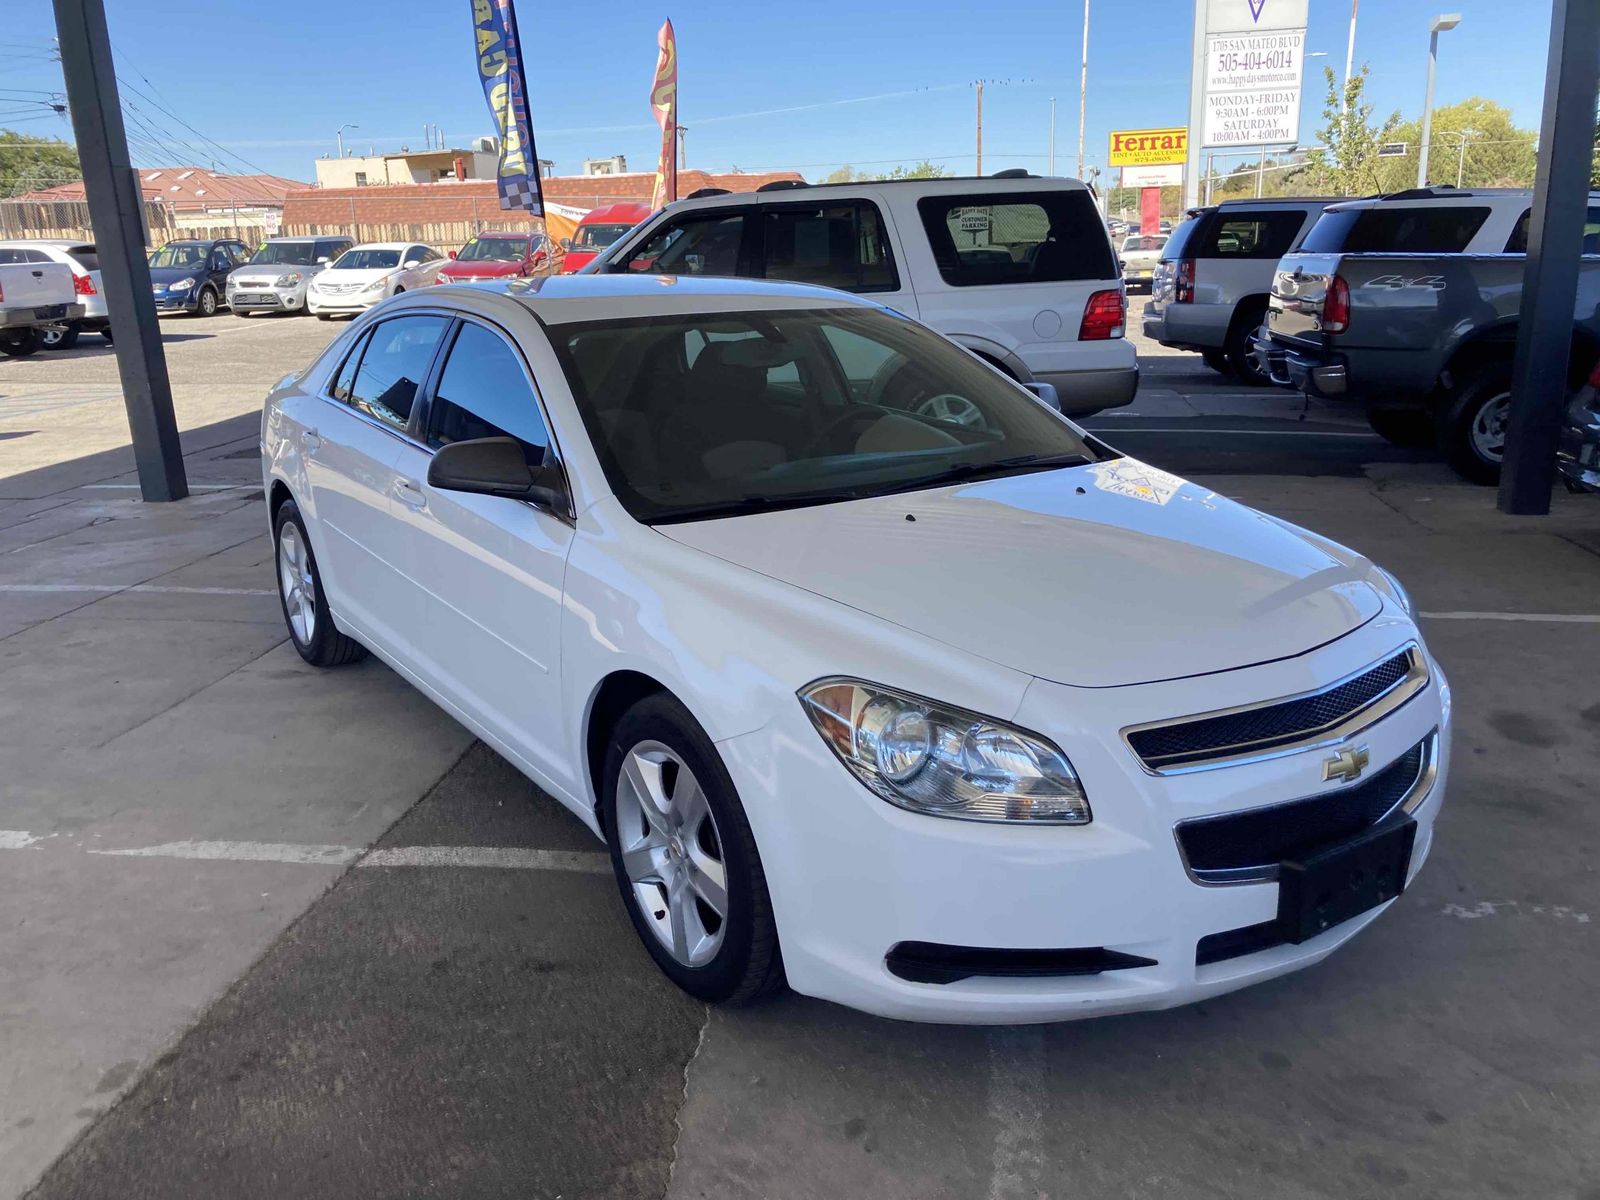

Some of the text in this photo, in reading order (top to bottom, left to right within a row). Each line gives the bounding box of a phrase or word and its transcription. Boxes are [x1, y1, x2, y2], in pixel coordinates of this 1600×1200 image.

[1213, 36, 1300, 52] 1705 SAN MATEO BLVD
[1218, 50, 1292, 72] 505-404-6014
[1212, 72, 1297, 88] www.happydaysmotorco.com
[1209, 92, 1296, 107] MONDAY-FRIDAY
[1215, 107, 1249, 118] 9:30AM
[1256, 105, 1289, 116] 6:00PM
[1223, 119, 1279, 131] SATURDAY
[1213, 131, 1250, 142] 10:00AM
[1257, 129, 1289, 140] 4:00PM
